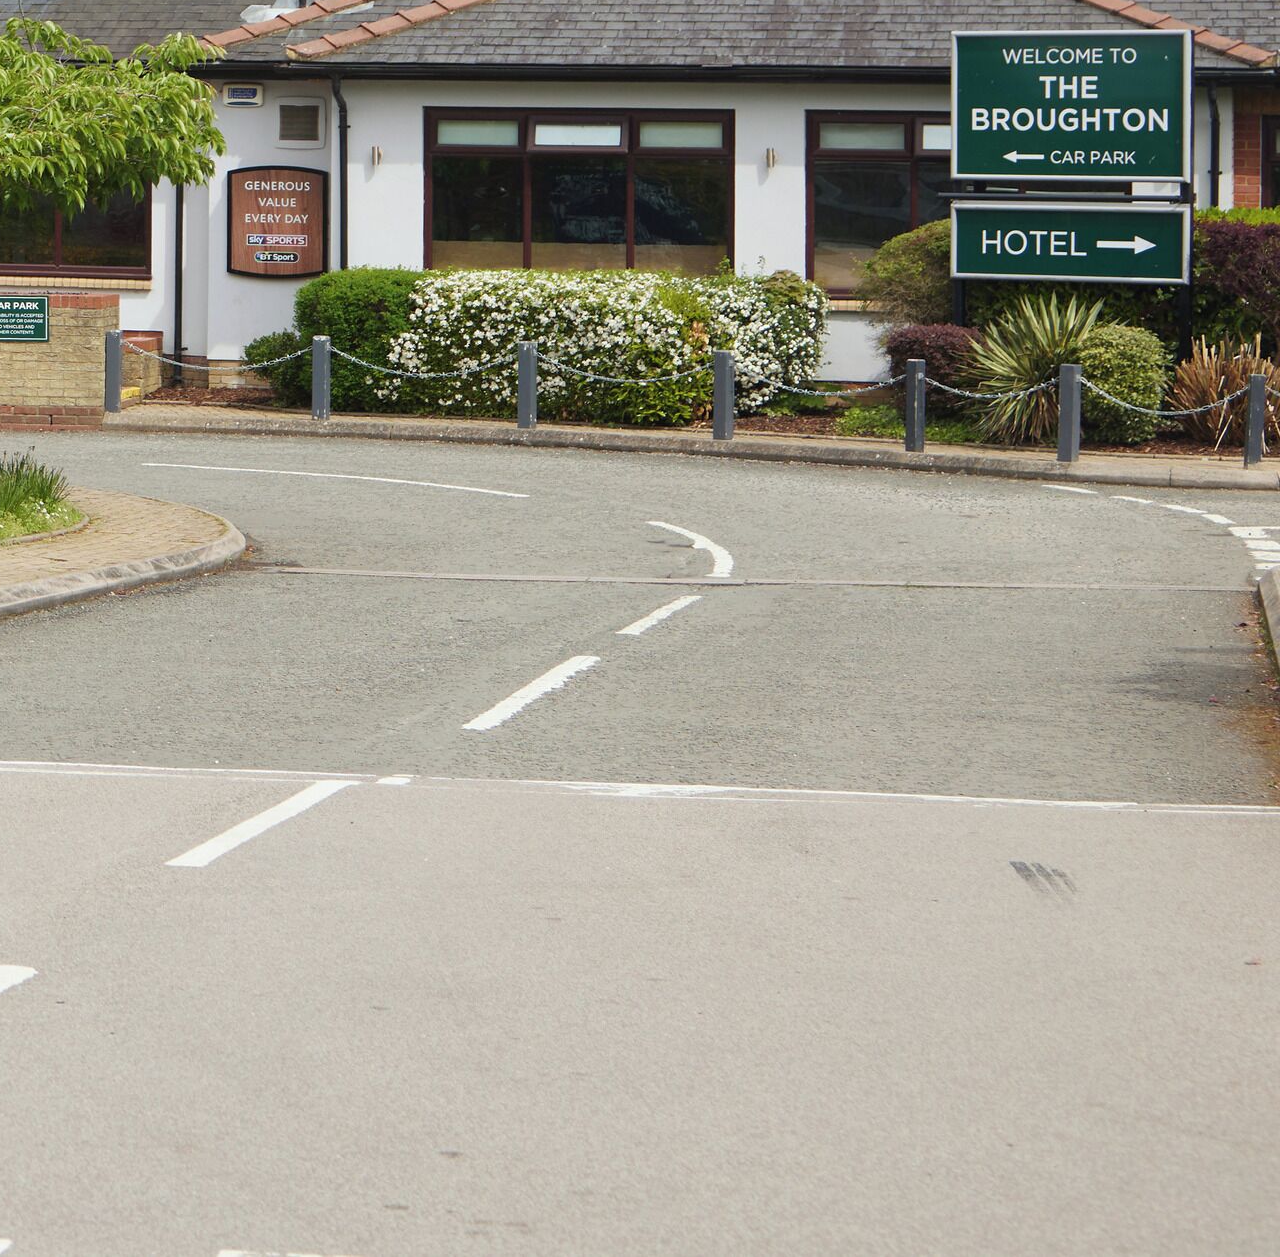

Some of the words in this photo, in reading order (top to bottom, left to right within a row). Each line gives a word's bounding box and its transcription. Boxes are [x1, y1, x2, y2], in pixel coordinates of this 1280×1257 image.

[1002, 48, 1104, 65] WELCOME
[1109, 47, 1137, 64] TO
[1038, 75, 1099, 99] THE
[971, 107, 1169, 132] BROUGHTON
[1050, 150, 1085, 164] CAR
[1090, 150, 1136, 165] PARK
[244, 180, 311, 192] GENEROUS
[258, 197, 297, 208] VALUE
[244, 213, 281, 224] EVERY
[285, 214, 309, 224] DAY
[248, 235, 264, 245] sky
[266, 235, 305, 245] SPORTS
[981, 229, 1088, 257] HOTEL
[259, 253, 272, 261] BT
[273, 253, 294, 263] Sport
[13, 302, 39, 310] PARK
